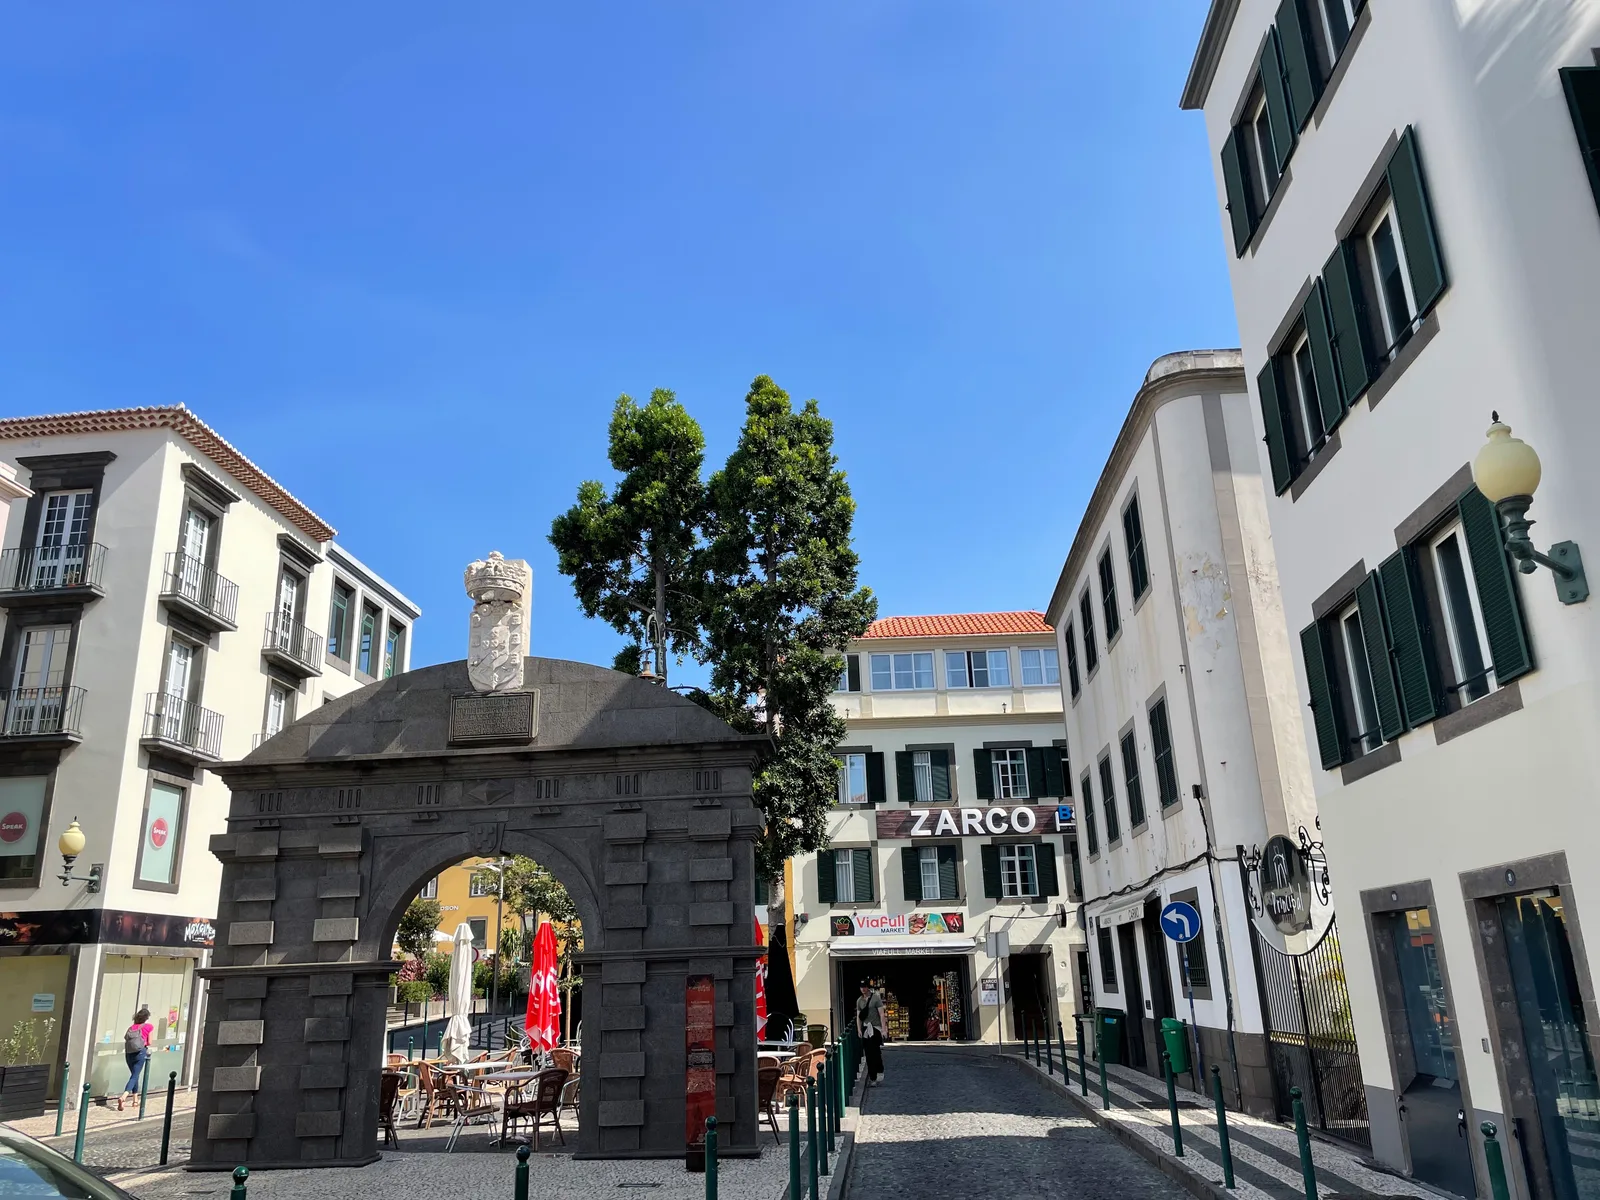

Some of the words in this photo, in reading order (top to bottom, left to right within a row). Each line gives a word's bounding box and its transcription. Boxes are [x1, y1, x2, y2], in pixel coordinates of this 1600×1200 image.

[910, 806, 1036, 836] ZARCO
[871, 948, 902, 956] VIAFULL
[905, 947, 935, 955] MARKET
